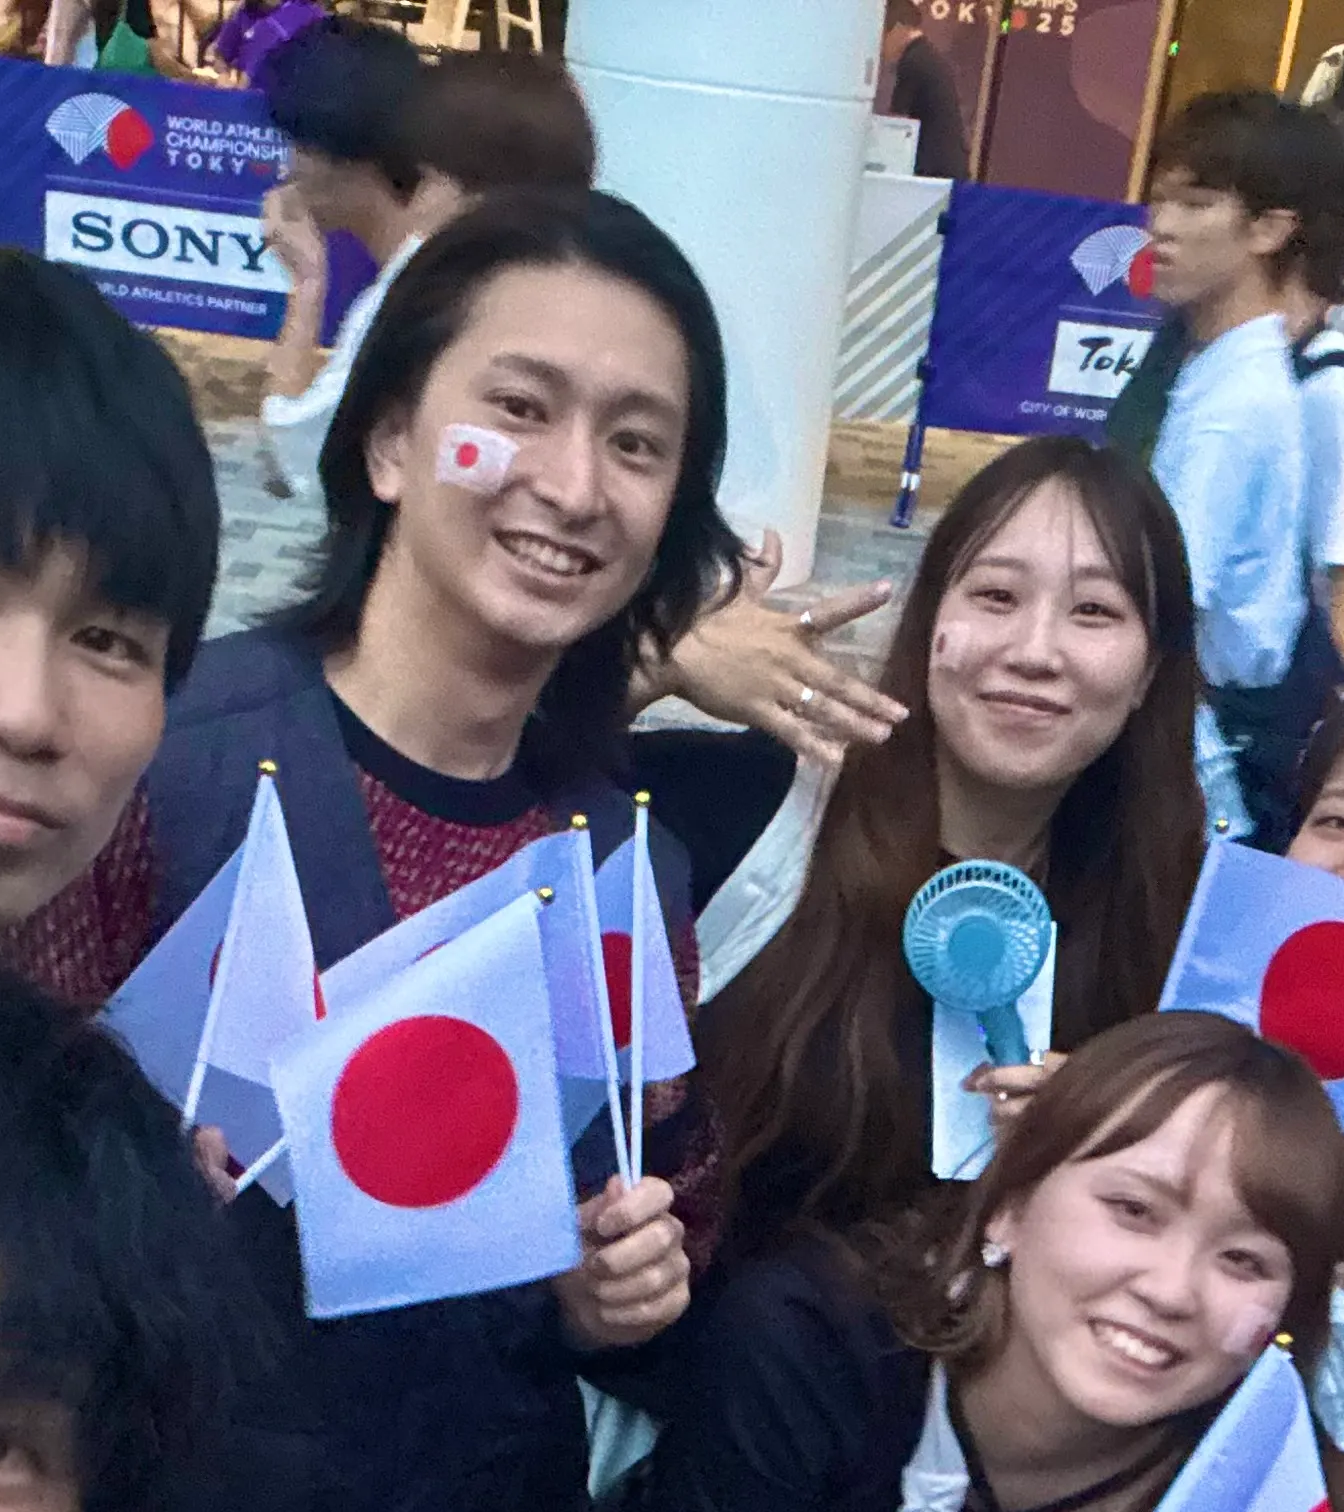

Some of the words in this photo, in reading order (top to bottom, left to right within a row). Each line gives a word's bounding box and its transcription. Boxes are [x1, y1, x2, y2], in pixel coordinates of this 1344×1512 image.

[166, 114, 223, 136] WORLD
[165, 131, 289, 161] CHAMPIONSHI
[71, 210, 270, 273] SONY
[131, 286, 205, 308] ATHLETICS
[206, 296, 269, 316] PARTNER
[1078, 336, 1141, 377] Tok
[1074, 406, 1108, 421] WOR
